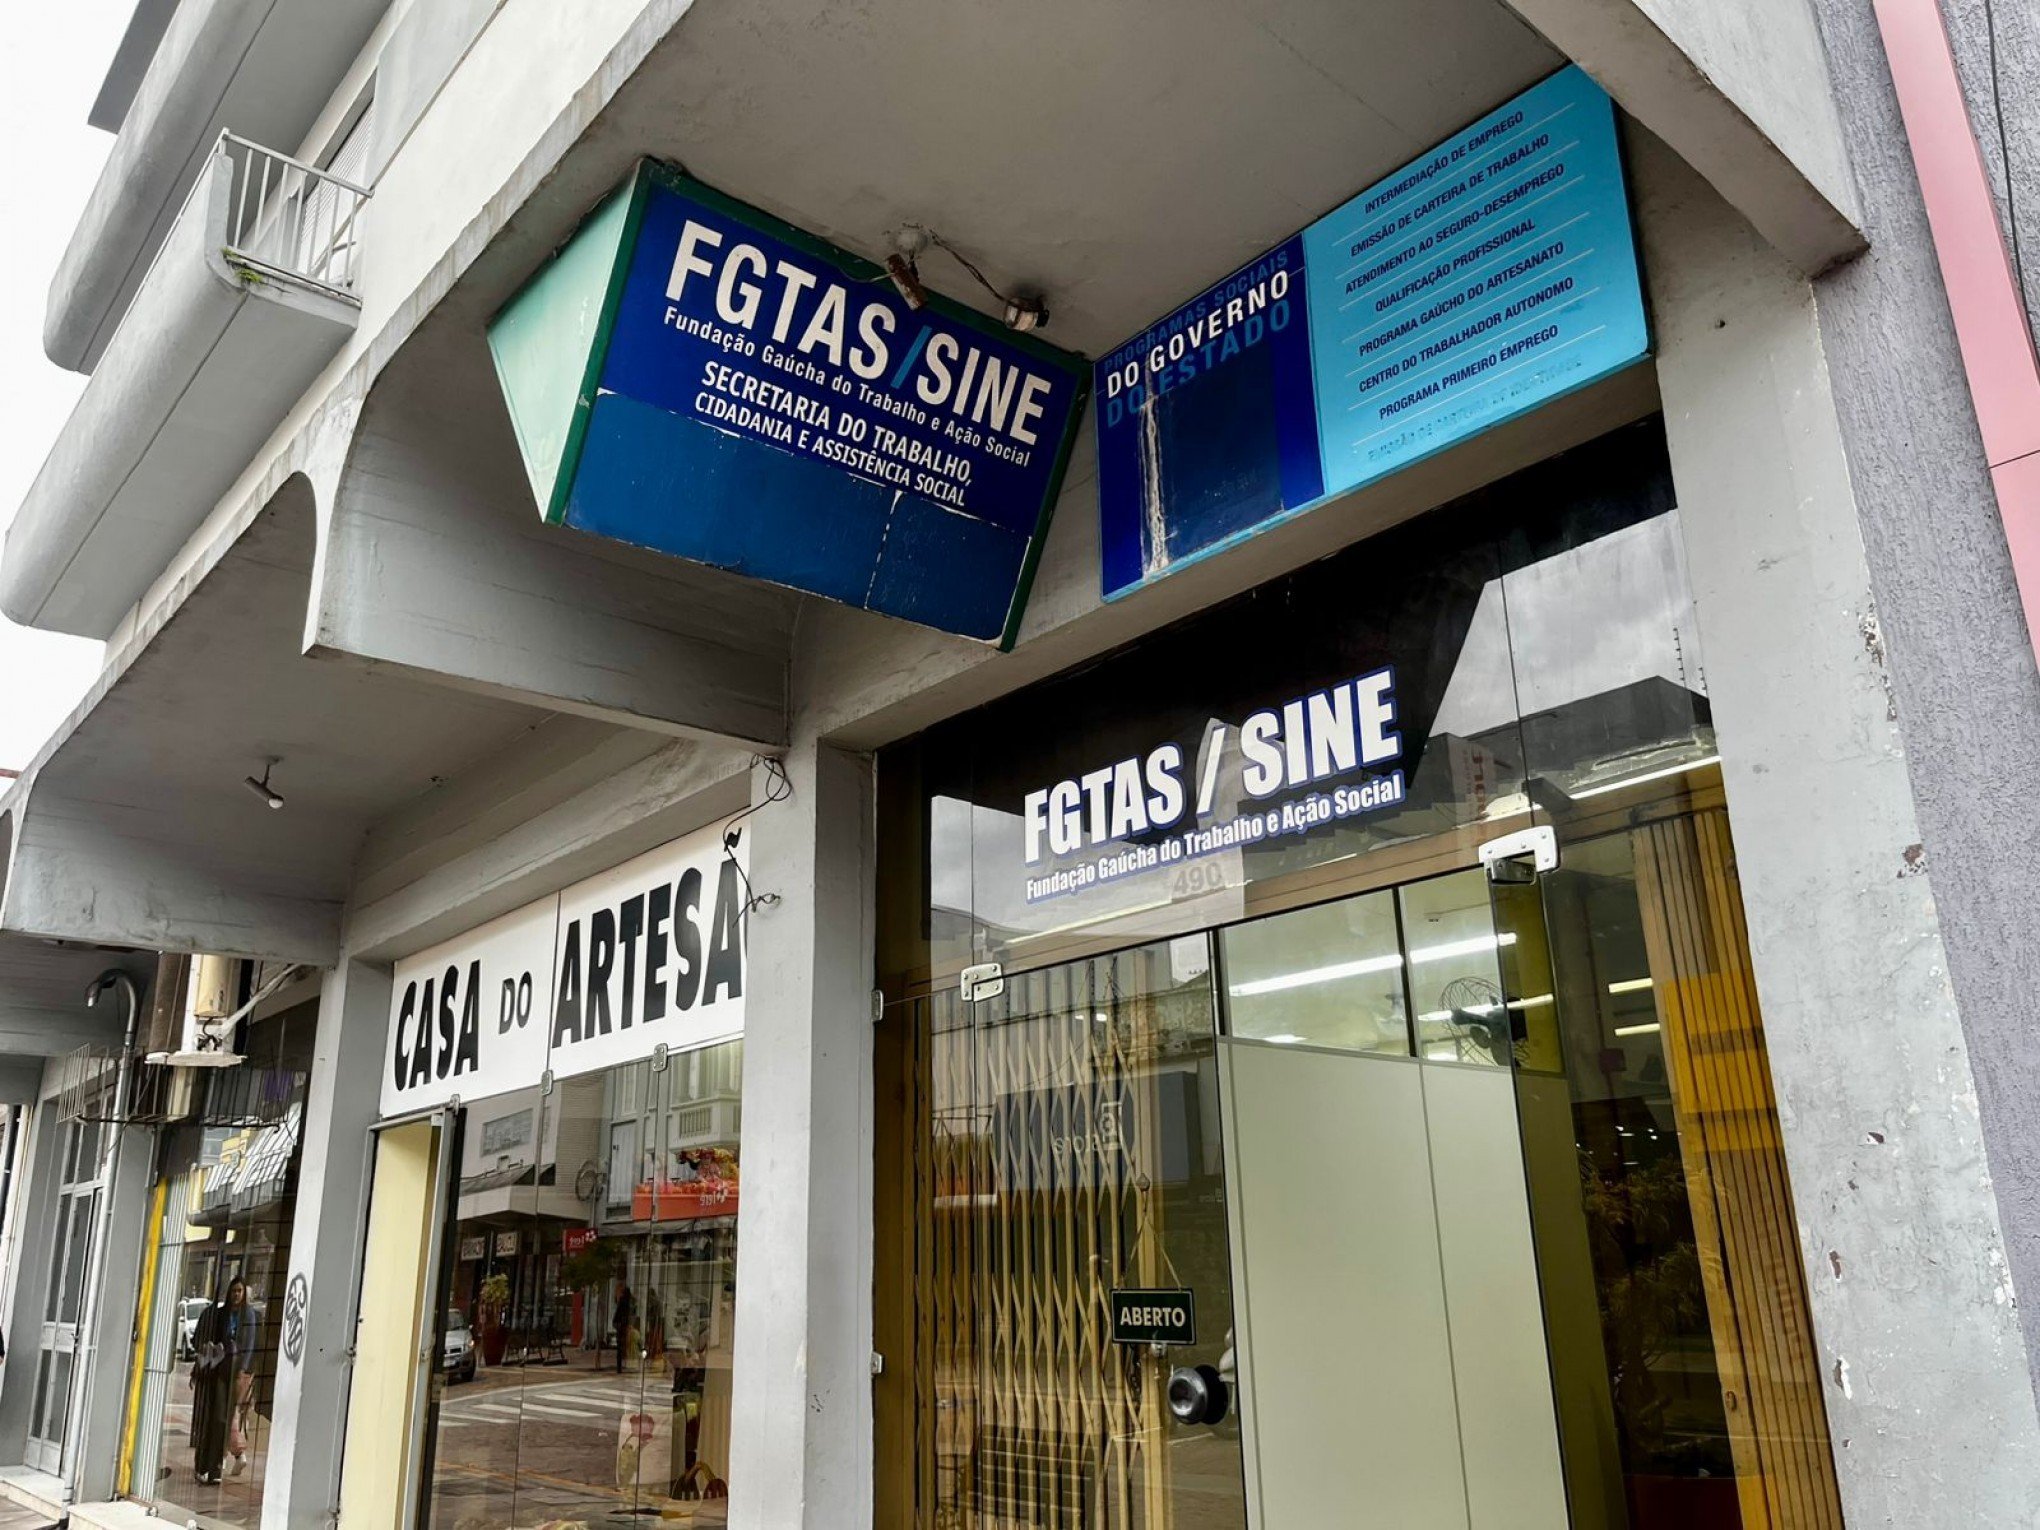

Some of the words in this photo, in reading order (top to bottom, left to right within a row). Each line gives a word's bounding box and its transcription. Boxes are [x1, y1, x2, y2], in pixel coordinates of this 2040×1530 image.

[1350, 221, 1396, 257] EMISSÃO
[1398, 214, 1412, 229] DE
[1413, 182, 1467, 220] CARTEIRA
[1469, 170, 1485, 188] DE
[1486, 133, 1549, 177] TRABALHO
[1365, 155, 1449, 214] INTERMEDIAÇÃO
[1451, 147, 1466, 162] DE
[1468, 110, 1524, 152] EMPREGO
[1345, 246, 1416, 295] ATENDIMENTO
[1418, 236, 1434, 254] AO
[1436, 162, 1564, 243] SEGURO-DESEMPREGO
[1375, 263, 1451, 312] QUALIFICAÇÃO
[1452, 218, 1536, 271] PROFISSIONAL
[1103, 301, 1207, 375] PROGRAMAS
[1214, 250, 1289, 307] SOCIAIS
[1107, 361, 1139, 398] DO
[1149, 270, 1289, 372] GOVERNO
[1359, 320, 1418, 357] PROGRAMA
[1420, 292, 1466, 324] GAÚCHO
[1467, 284, 1485, 300] DO
[1486, 241, 1564, 291] ARTESANATO
[1359, 362, 1400, 392] CENTRO
[1402, 355, 1417, 371] DO
[1419, 312, 1502, 363] TRABALHADOR
[1505, 277, 1574, 321] AUTONOMO
[664, 306, 755, 356] Fundação
[761, 345, 826, 385] Gaúcha
[831, 375, 852, 395] do
[859, 383, 926, 425] Trabalho
[931, 417, 941, 430] e
[944, 420, 982, 447] Ação
[985, 436, 1031, 467] Social
[701, 360, 831, 430] SECRETARIA
[837, 412, 867, 442] DO
[873, 425, 972, 486] TRABALHO,
[1107, 385, 1145, 428] DO
[1158, 299, 1290, 395] ESTADO
[1379, 382, 1440, 419] PROGRAMA
[1442, 353, 1498, 389] PRIMEIRO
[1500, 324, 1559, 362] EMPREGO
[694, 392, 793, 444] CIDADANIA
[797, 430, 808, 449] E
[811, 435, 910, 486] ASSISTÊNCIA
[914, 473, 965, 506] SOCIAL
[1024, 744, 1184, 864] FGTAS
[1240, 670, 1399, 796] SINE
[1027, 863, 1096, 900] Fundação
[1098, 847, 1157, 880] Gaúcha
[1159, 838, 1181, 862] do
[1183, 817, 1263, 855] Trabalho
[1266, 813, 1279, 831] e
[1282, 796, 1331, 831] Ação
[1334, 773, 1401, 815] Social
[1173, 862, 1223, 895] 490
[394, 958, 481, 1092] CASA
[499, 970, 533, 1035] DO
[551, 827, 748, 1049] ARTESÃ
[1120, 1306, 1186, 1327] ABERTO
